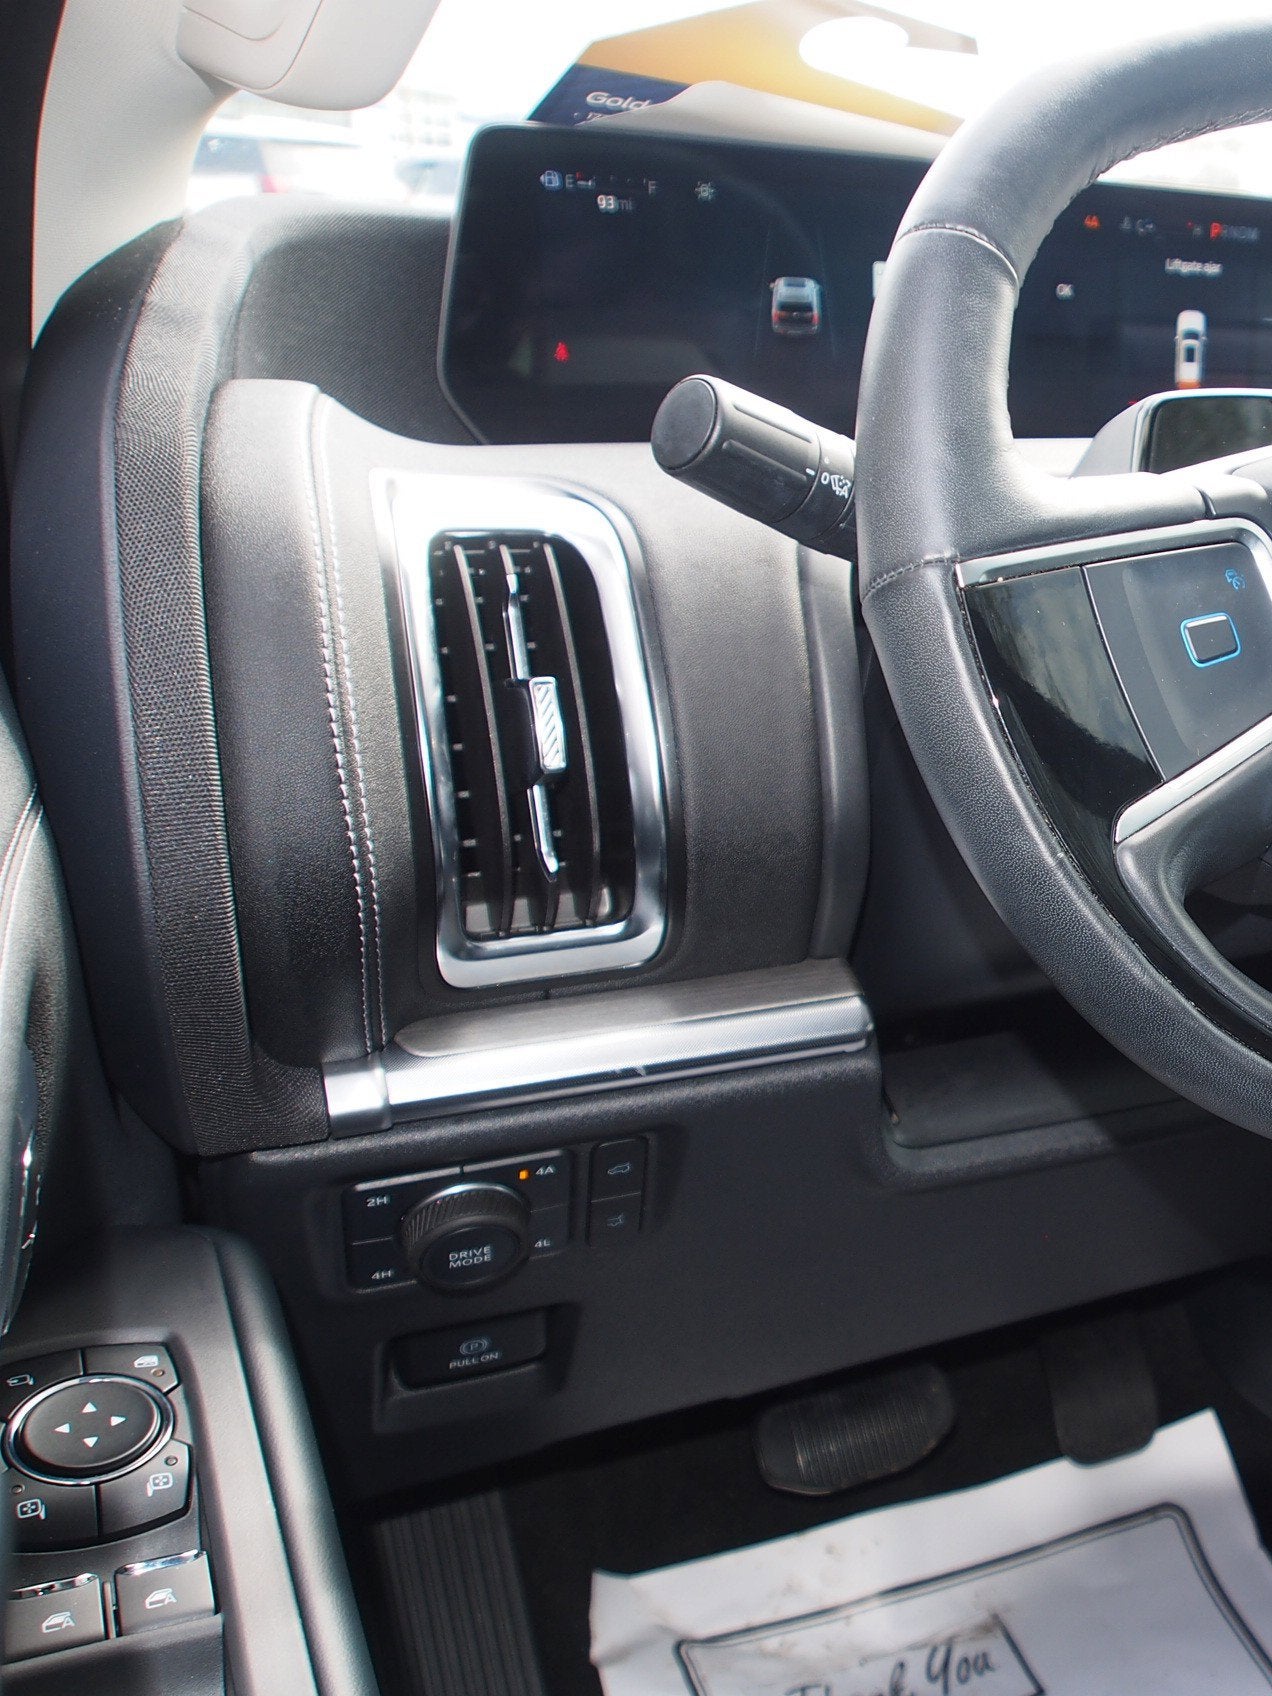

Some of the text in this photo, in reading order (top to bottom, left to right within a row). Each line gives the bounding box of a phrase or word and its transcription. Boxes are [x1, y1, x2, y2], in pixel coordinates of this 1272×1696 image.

[585, 91, 651, 111] Gold
[596, 194, 616, 211] 93
[534, 1166, 555, 1177] 4A
[366, 1196, 388, 1208] 2H
[534, 1238, 551, 1249] 4L
[448, 1245, 492, 1261] DRIVE
[448, 1254, 492, 1269] MODE
[371, 1269, 392, 1281] 4H
[448, 1351, 499, 1370] PULL ON
[924, 1636, 999, 1695] You
